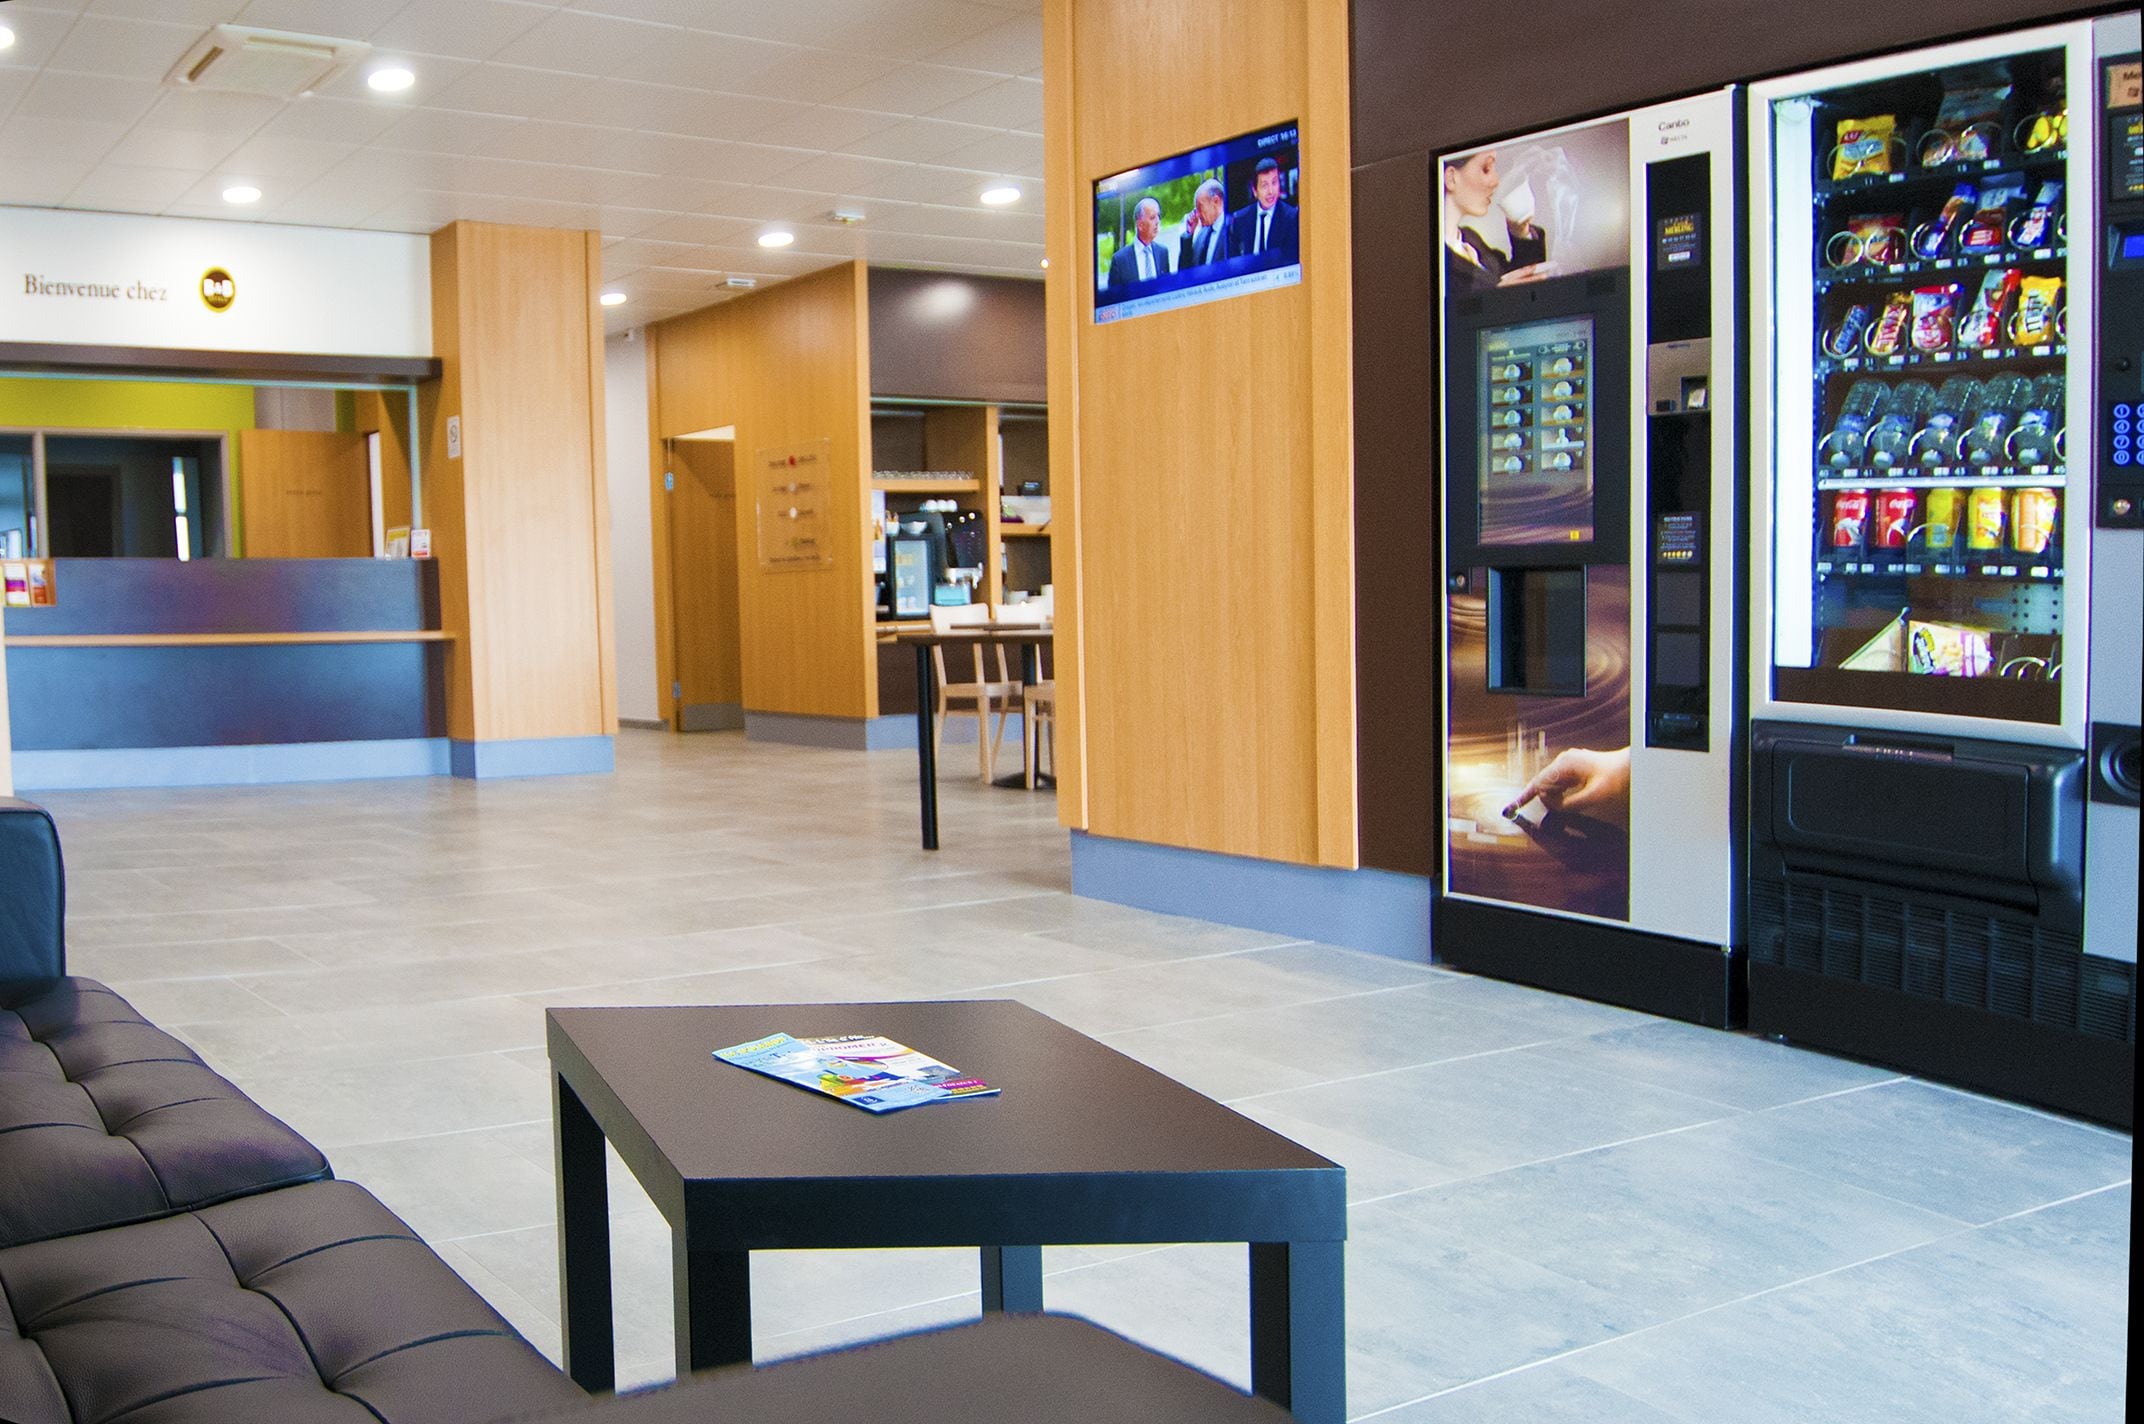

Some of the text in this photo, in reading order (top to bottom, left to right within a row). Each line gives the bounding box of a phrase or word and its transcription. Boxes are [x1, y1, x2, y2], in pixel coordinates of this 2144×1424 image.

[1658, 118, 1691, 132] Canto
[24, 272, 120, 299] Bienvenue
[126, 280, 168, 302] chez
[2003, 466, 2014, 475] 44
